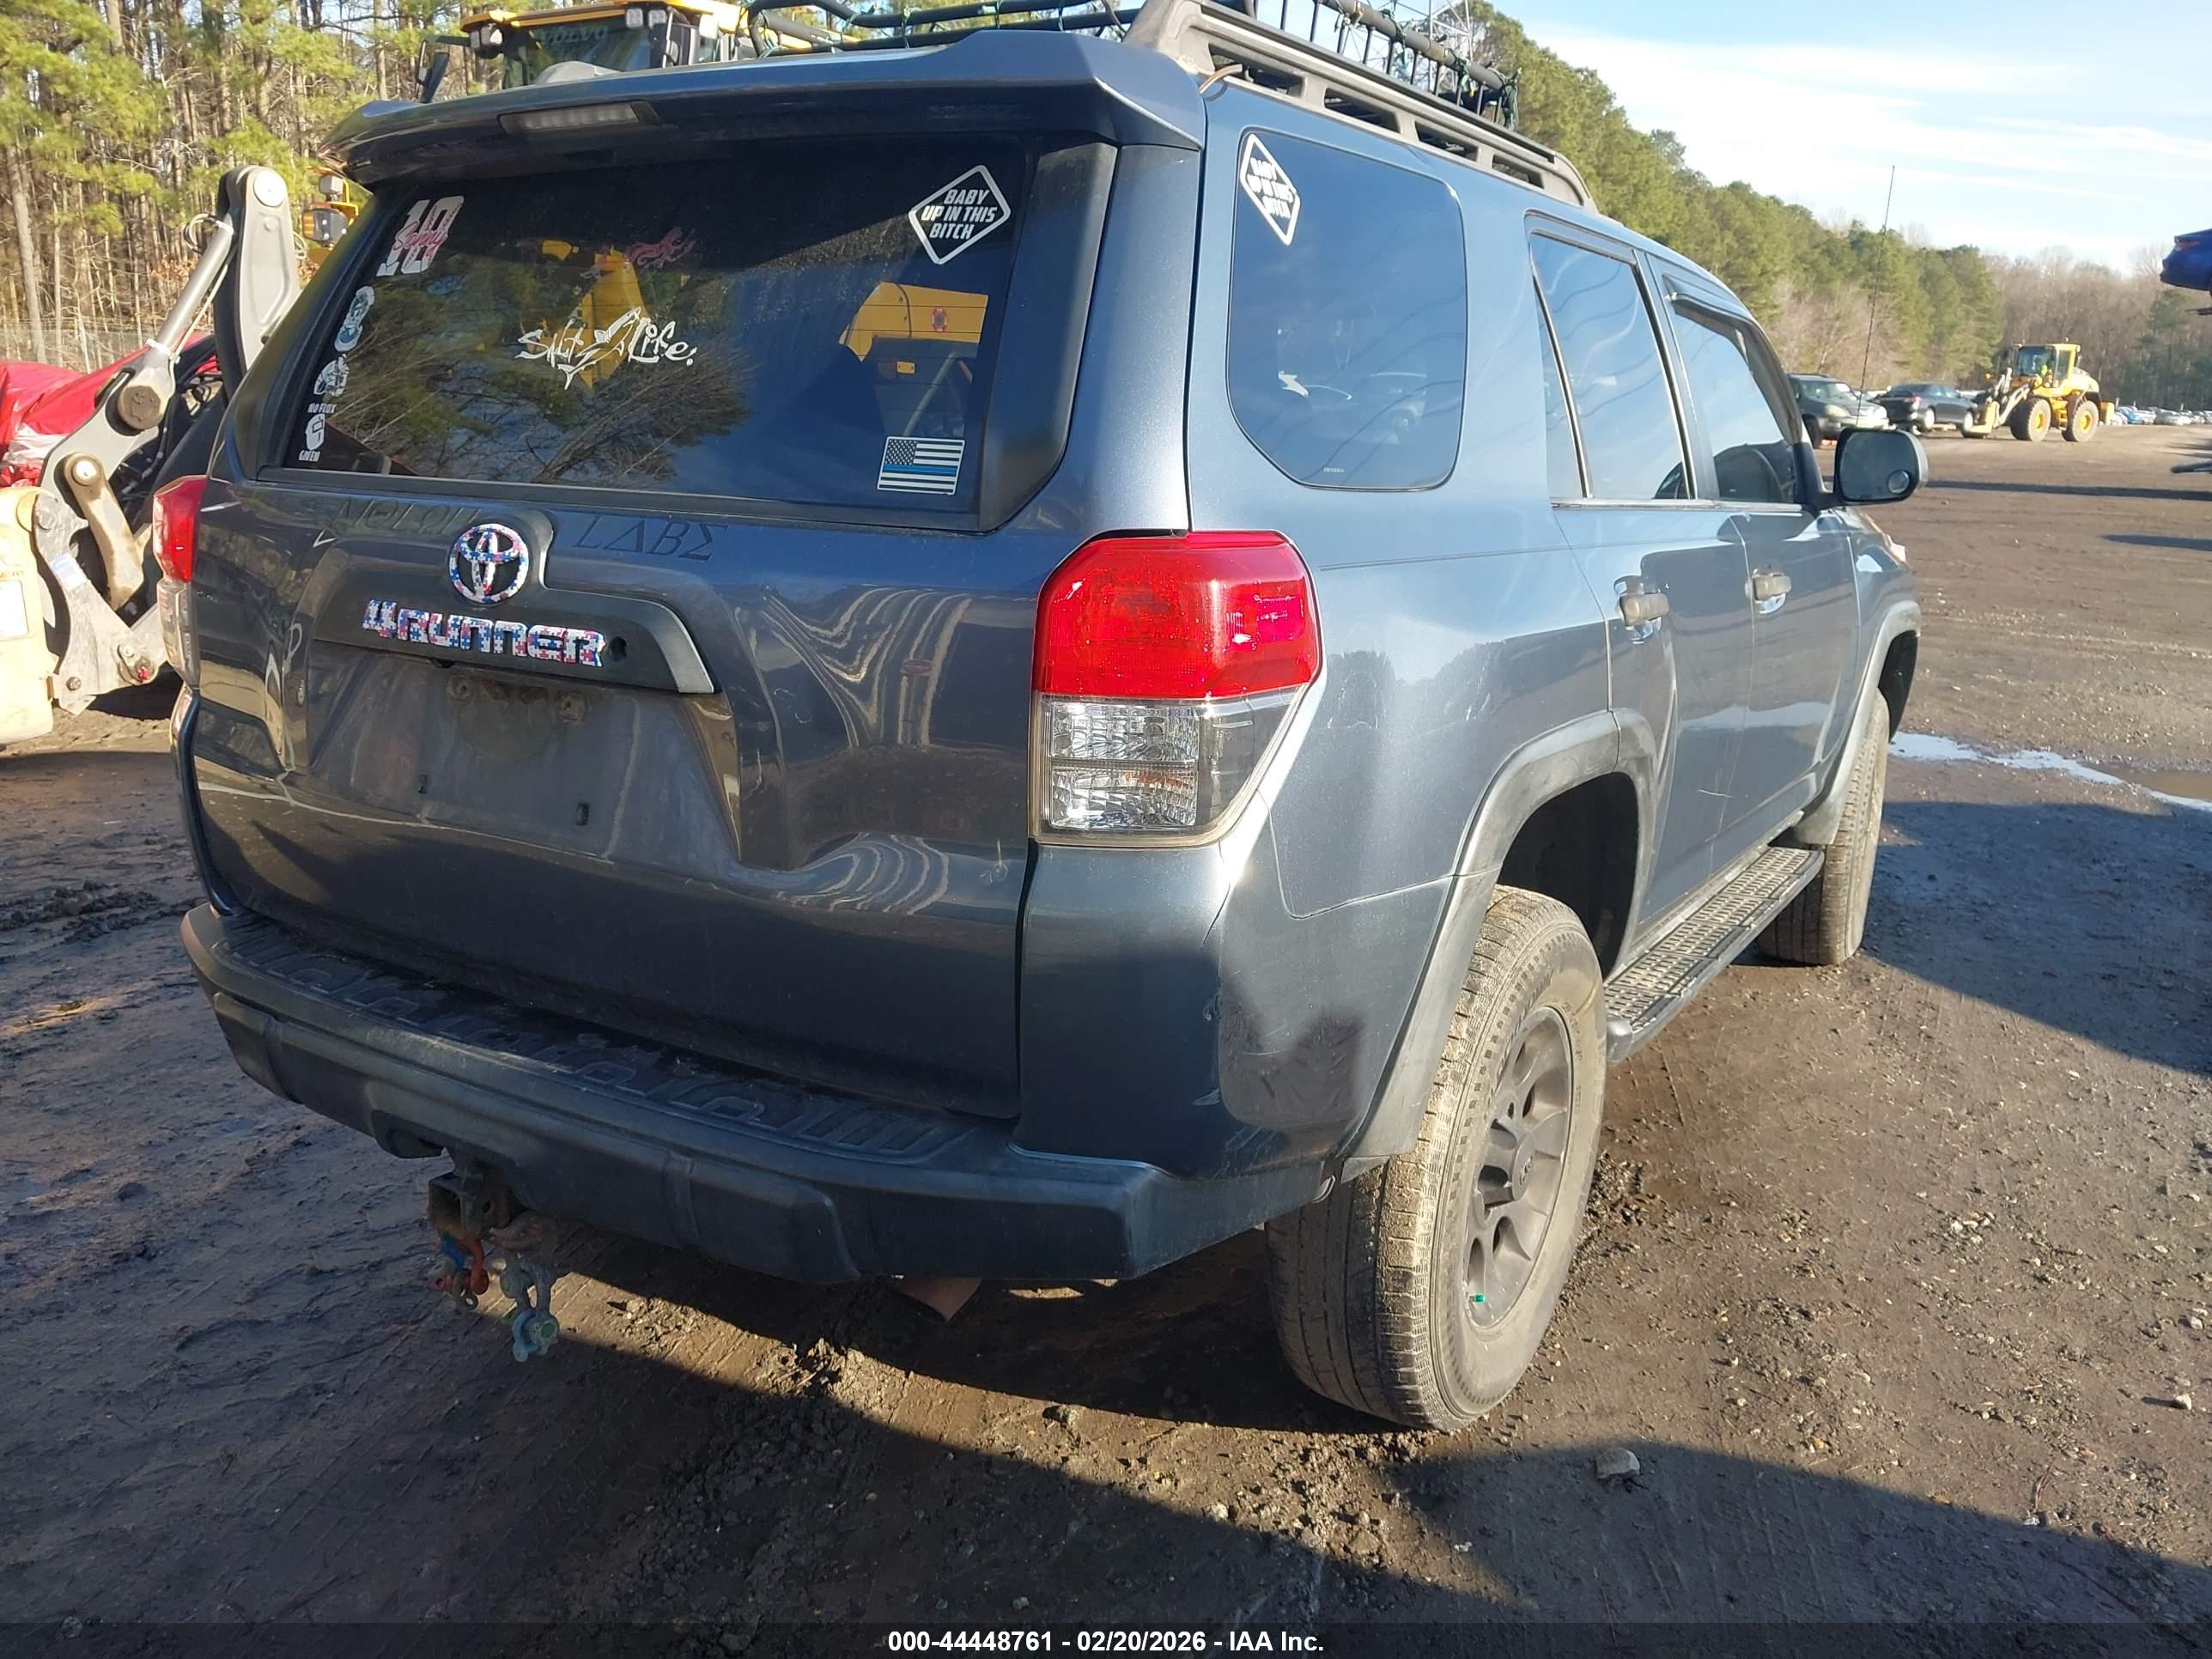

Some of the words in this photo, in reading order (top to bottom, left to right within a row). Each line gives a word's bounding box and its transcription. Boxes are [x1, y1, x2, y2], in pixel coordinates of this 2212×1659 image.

[944, 189, 989, 205] BABY
[921, 205, 944, 222] UP
[944, 206, 963, 222] IN
[963, 206, 998, 222] THIS
[929, 222, 975, 240] BITCH
[307, 403, 319, 414] NO
